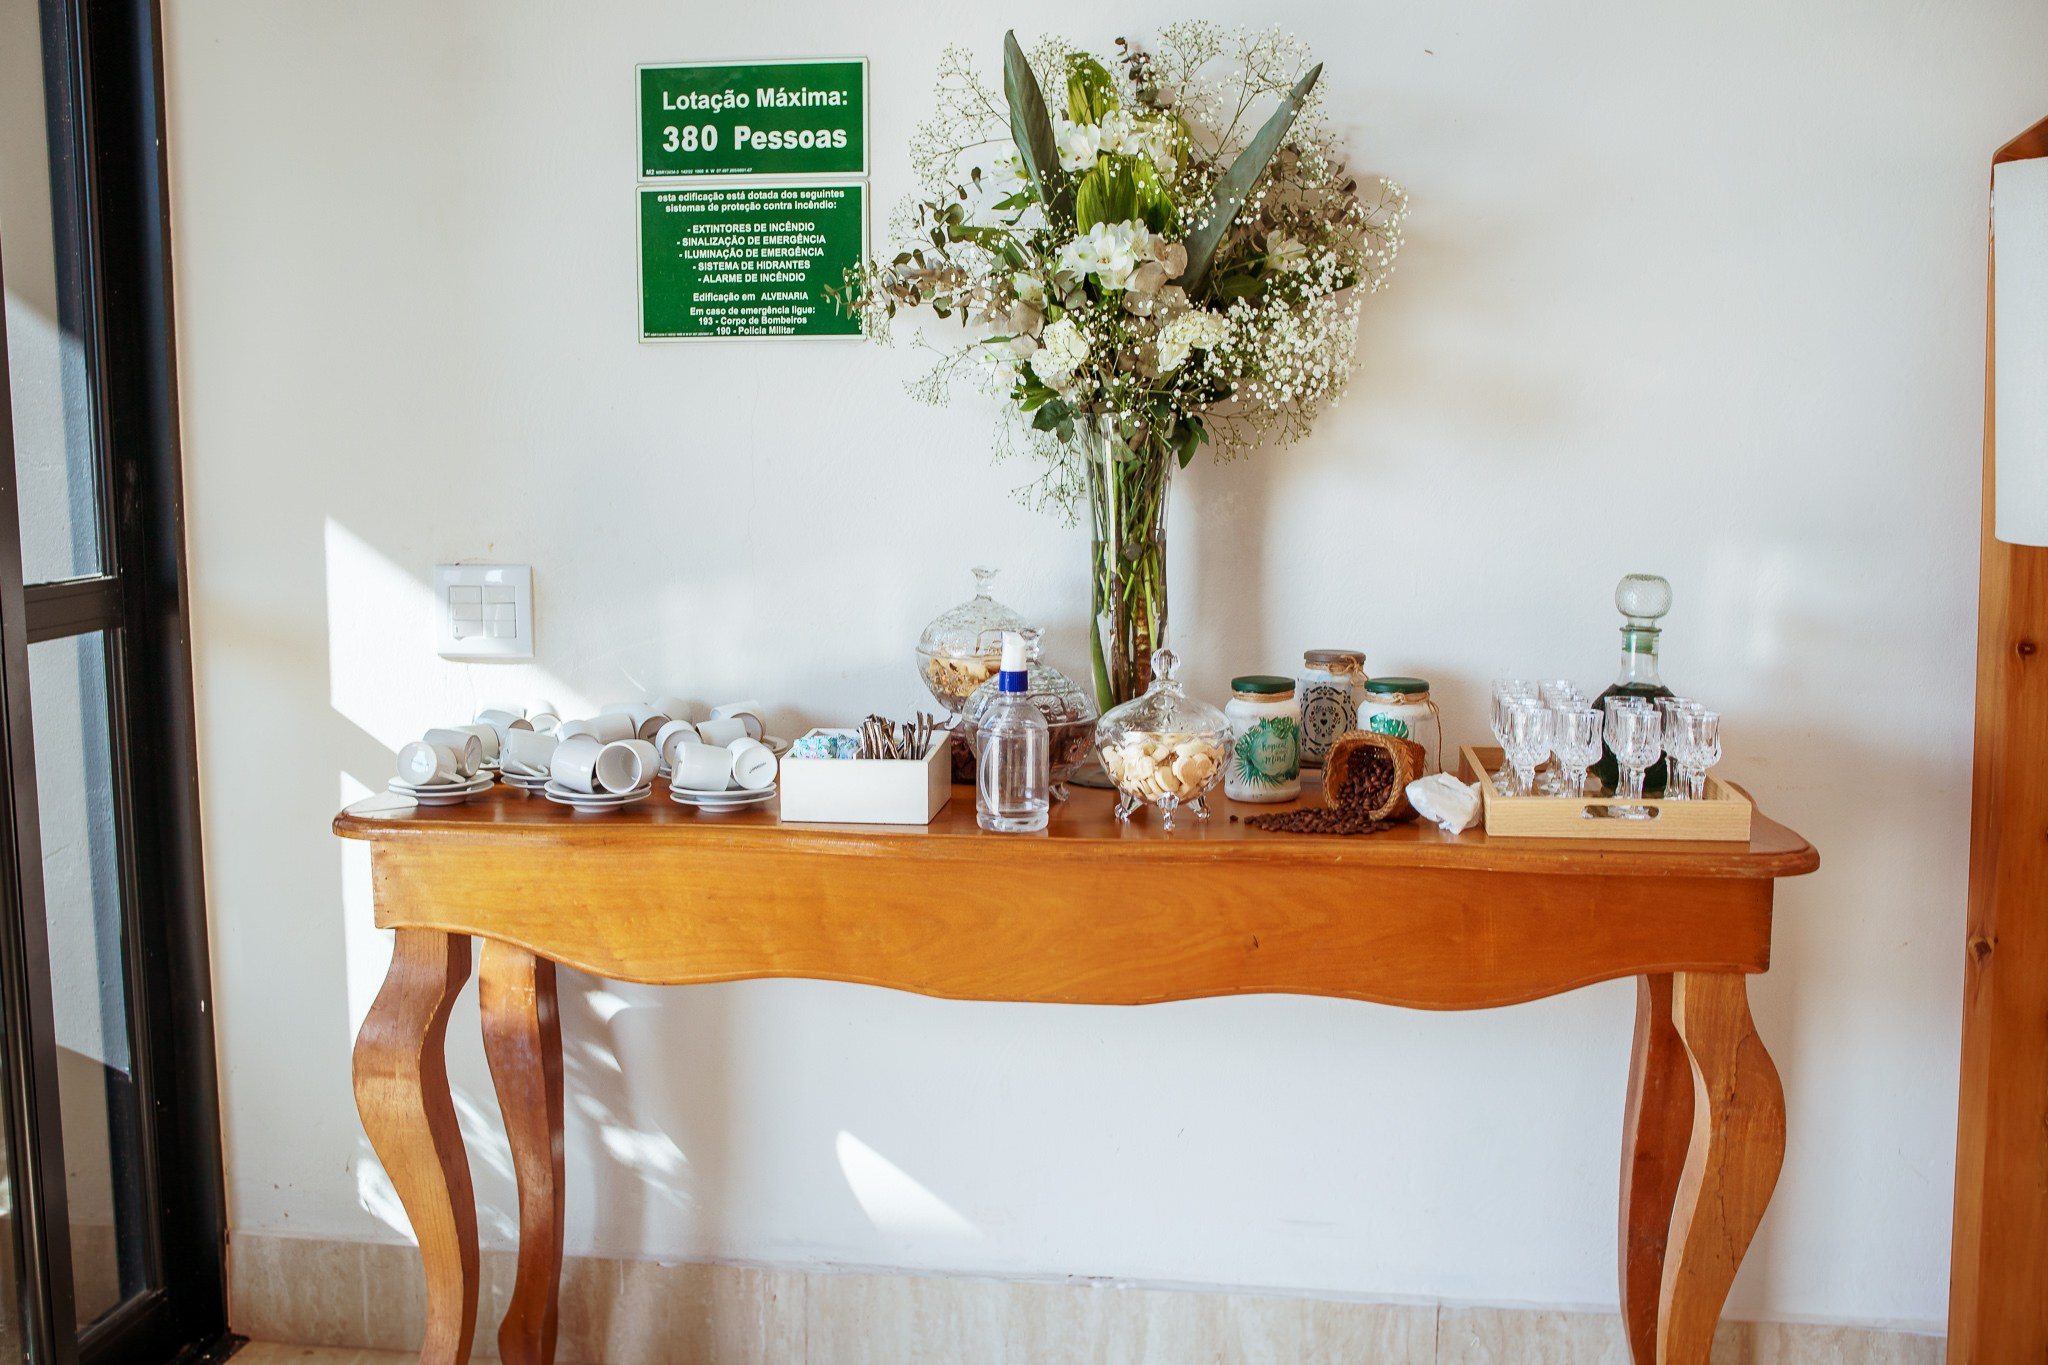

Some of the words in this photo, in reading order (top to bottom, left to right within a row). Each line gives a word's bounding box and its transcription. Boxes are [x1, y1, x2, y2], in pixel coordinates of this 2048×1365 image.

[663, 89, 750, 113] Lotação
[757, 87, 847, 107] Máxima:
[662, 125, 718, 152] 380
[734, 125, 847, 150] Pessoas
[658, 194, 676, 202] esta
[679, 191, 724, 203] edificação
[727, 190, 745, 200] está
[748, 190, 778, 200] dotada
[781, 190, 798, 199] dos
[800, 189, 844, 200] seguintes
[666, 203, 705, 212] sistemas
[708, 203, 718, 211] de
[721, 201, 761, 212] proteção
[763, 201, 792, 210] contra
[693, 223, 752, 234] EXTINTORES
[754, 223, 766, 232] DE
[769, 221, 815, 232] INCÊNDIO
[682, 236, 745, 247] SINALIZAÇÃO
[748, 236, 760, 245] DE
[763, 233, 826, 245] EMERGÊNCIA
[685, 249, 744, 260] ILUMINAÇÃO
[746, 249, 758, 258] DE
[761, 246, 824, 257] EMERGÊNCIA
[698, 261, 740, 270] SISTEMA
[741, 261, 754, 270] DE
[757, 260, 811, 269] HIDRANTES
[703, 274, 743, 283] ALARME
[745, 273, 757, 282] DE
[760, 272, 805, 282] INCÊNDIO
[693, 292, 740, 302] Edificação
[761, 292, 808, 300] ALVENARIA
[690, 307, 704, 315] Em
[728, 306, 739, 315] de
[741, 305, 790, 316] emergência
[792, 306, 815, 315] ligue:
[699, 317, 713, 325] 193
[721, 317, 746, 327] Corpo
[749, 316, 759, 324] de
[761, 316, 807, 325] Bombeiros
[716, 327, 731, 335] 190
[738, 326, 767, 335] Polícia
[769, 326, 795, 334] Militar
